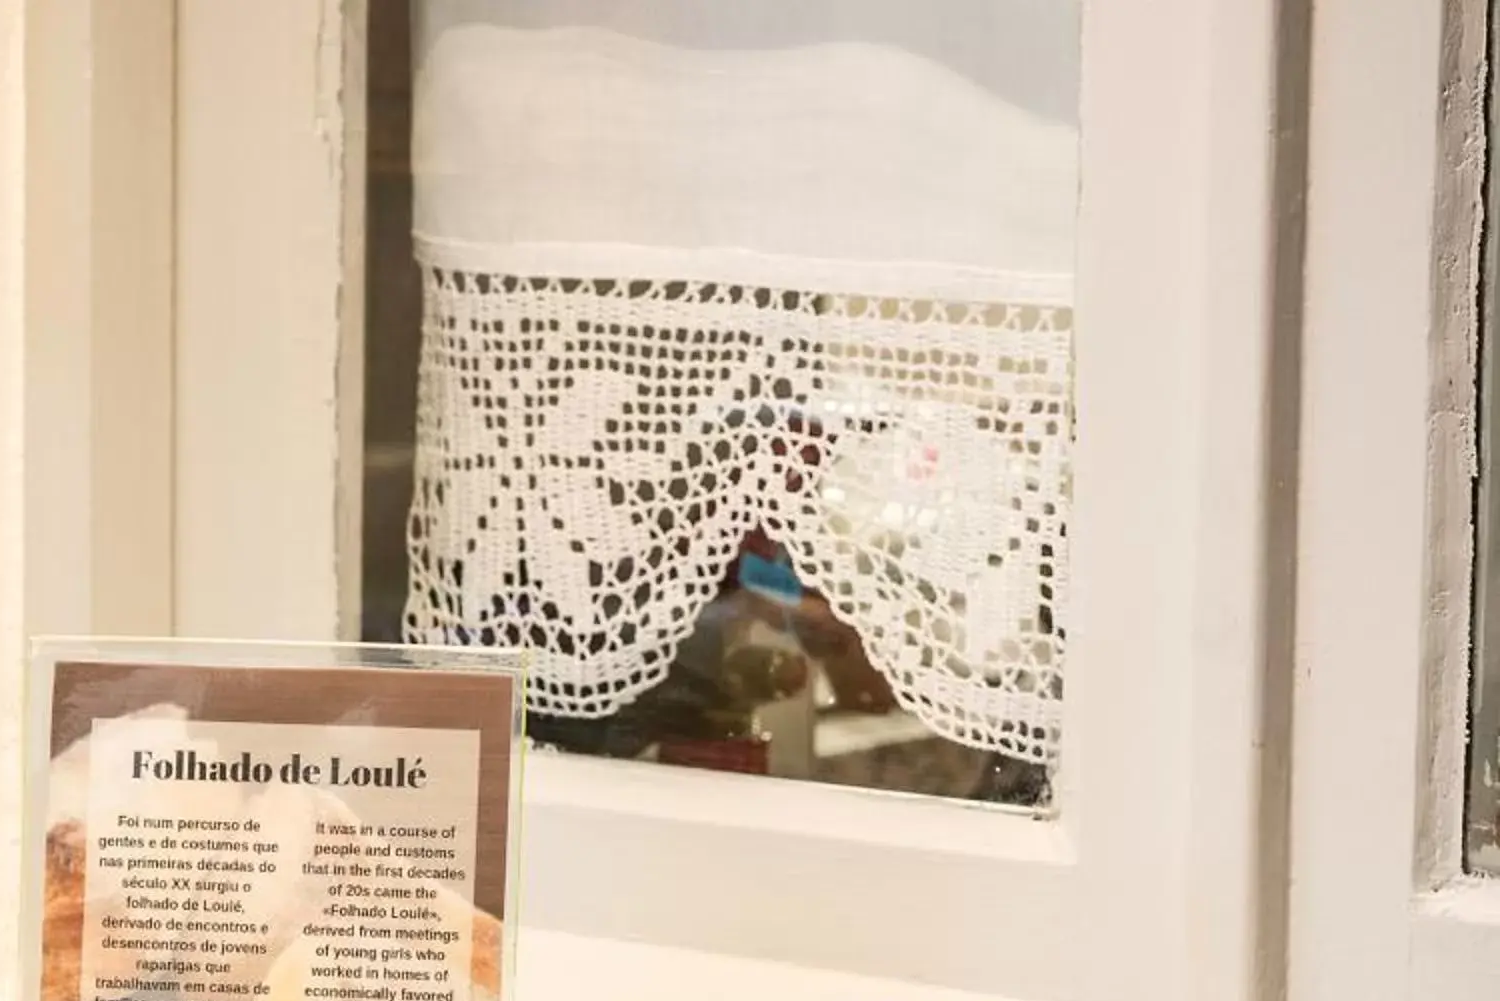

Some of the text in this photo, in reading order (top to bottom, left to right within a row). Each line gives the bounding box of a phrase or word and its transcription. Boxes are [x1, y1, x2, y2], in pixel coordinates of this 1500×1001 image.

[132, 750, 427, 788] Folhado de Loulé
[118, 815, 260, 832] Foi num percurso de
[316, 823, 456, 838] It was in course of
[98, 836, 279, 854] gentes de costumes que
[314, 844, 455, 859] people and customs
[99, 857, 276, 873] nas primeiras décadas do
[302, 863, 465, 880] that in the first decades
[122, 876, 238, 894] século XX surgiu
[328, 885, 437, 898] of 20s came the
[126, 896, 245, 913] folhado de Loulé,
[102, 918, 257, 933] derivado de encontros
[303, 924, 459, 943] derived from meetings
[102, 937, 267, 955] desencontros de jovens
[316, 945, 445, 961] of young girls who
[136, 959, 231, 975] raparigas que
[312, 966, 449, 981] worked in homes of
[96, 976, 270, 994] trabalhavam em casas de
[305, 986, 454, 1001] economically favored
